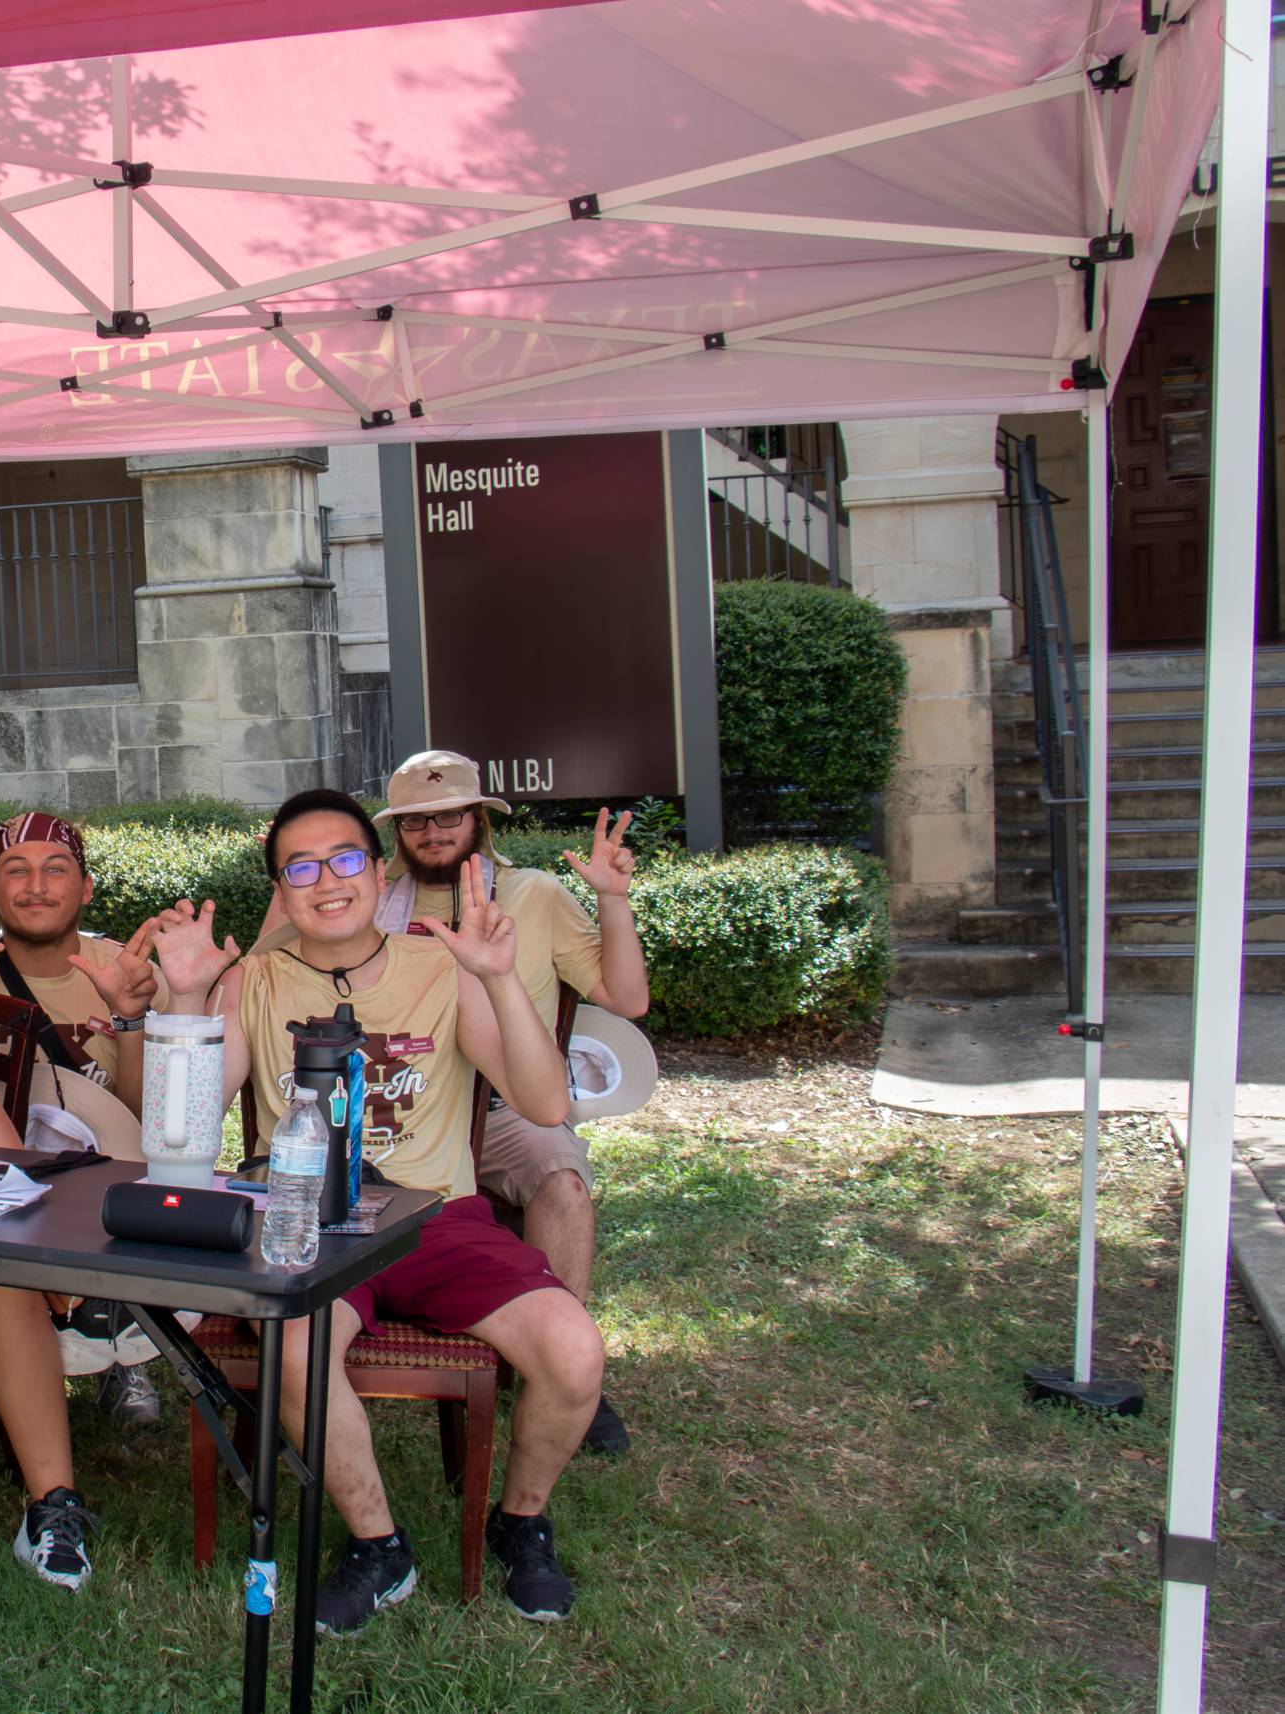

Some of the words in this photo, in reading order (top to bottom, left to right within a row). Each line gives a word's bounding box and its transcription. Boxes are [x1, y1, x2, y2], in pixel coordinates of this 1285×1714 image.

[425, 458, 540, 496] Mesquite
[427, 500, 474, 533] Hall
[488, 760, 505, 793] N
[513, 758, 554, 792] LBJ
